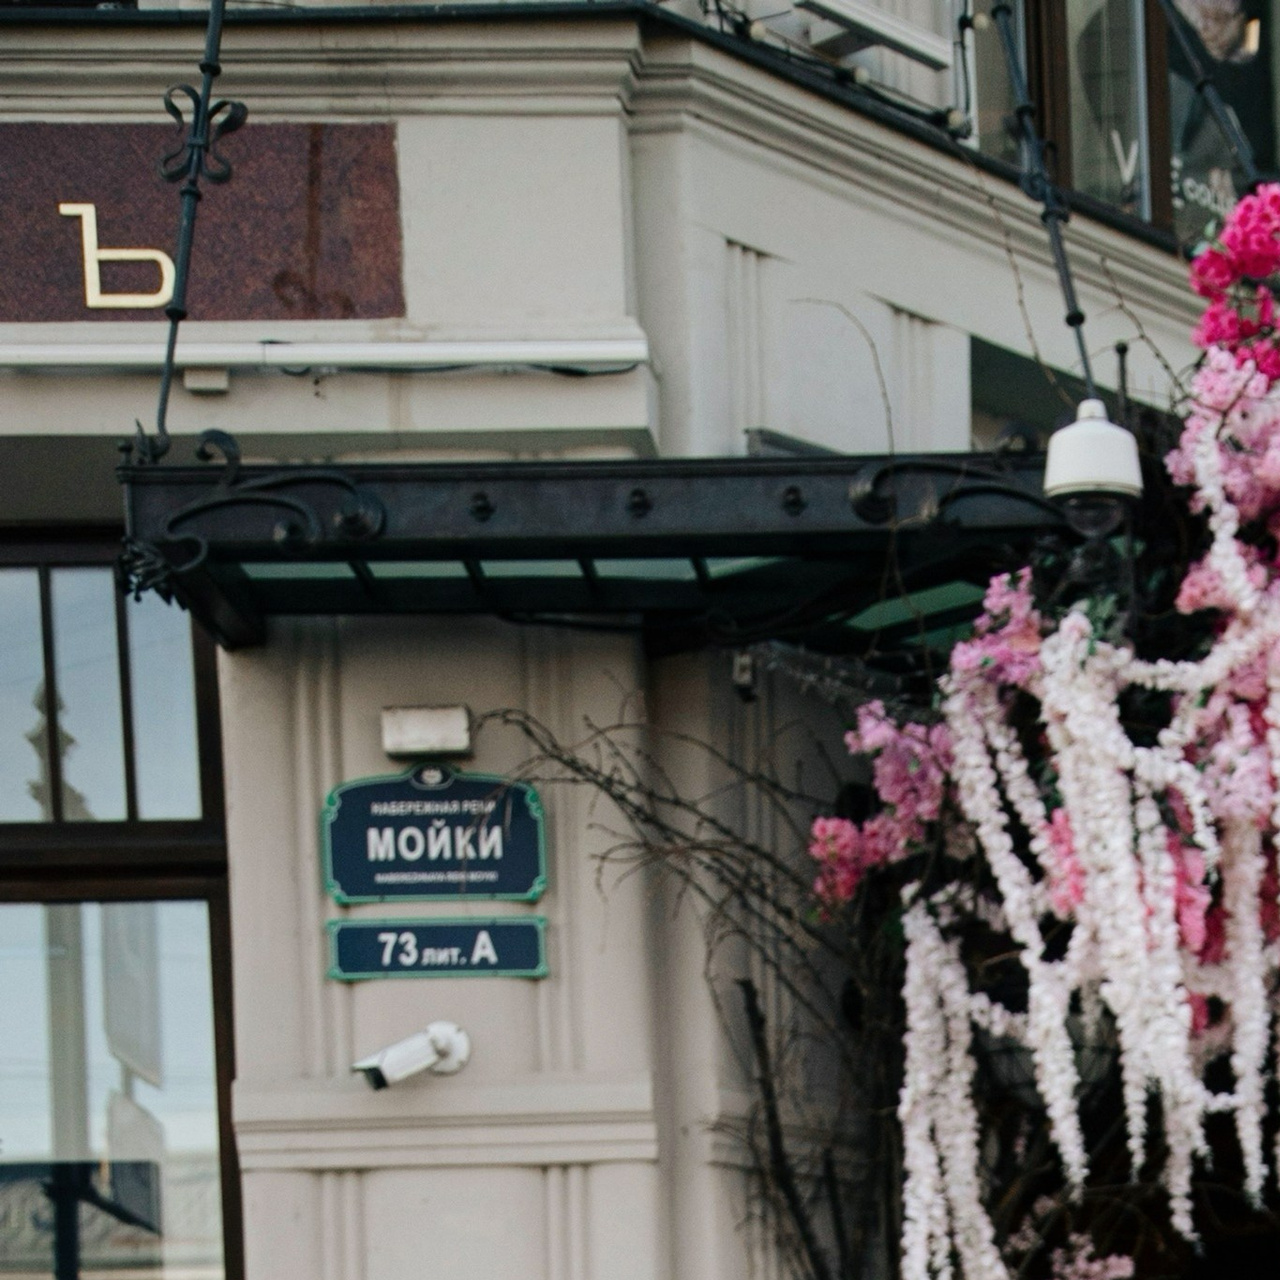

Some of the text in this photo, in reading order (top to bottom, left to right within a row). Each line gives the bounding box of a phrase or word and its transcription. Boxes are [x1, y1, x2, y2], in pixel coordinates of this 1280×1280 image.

[59, 203, 176, 308] Ъ
[366, 818, 503, 861] МОЙКИ
[377, 930, 499, 966] 73 лит. А
